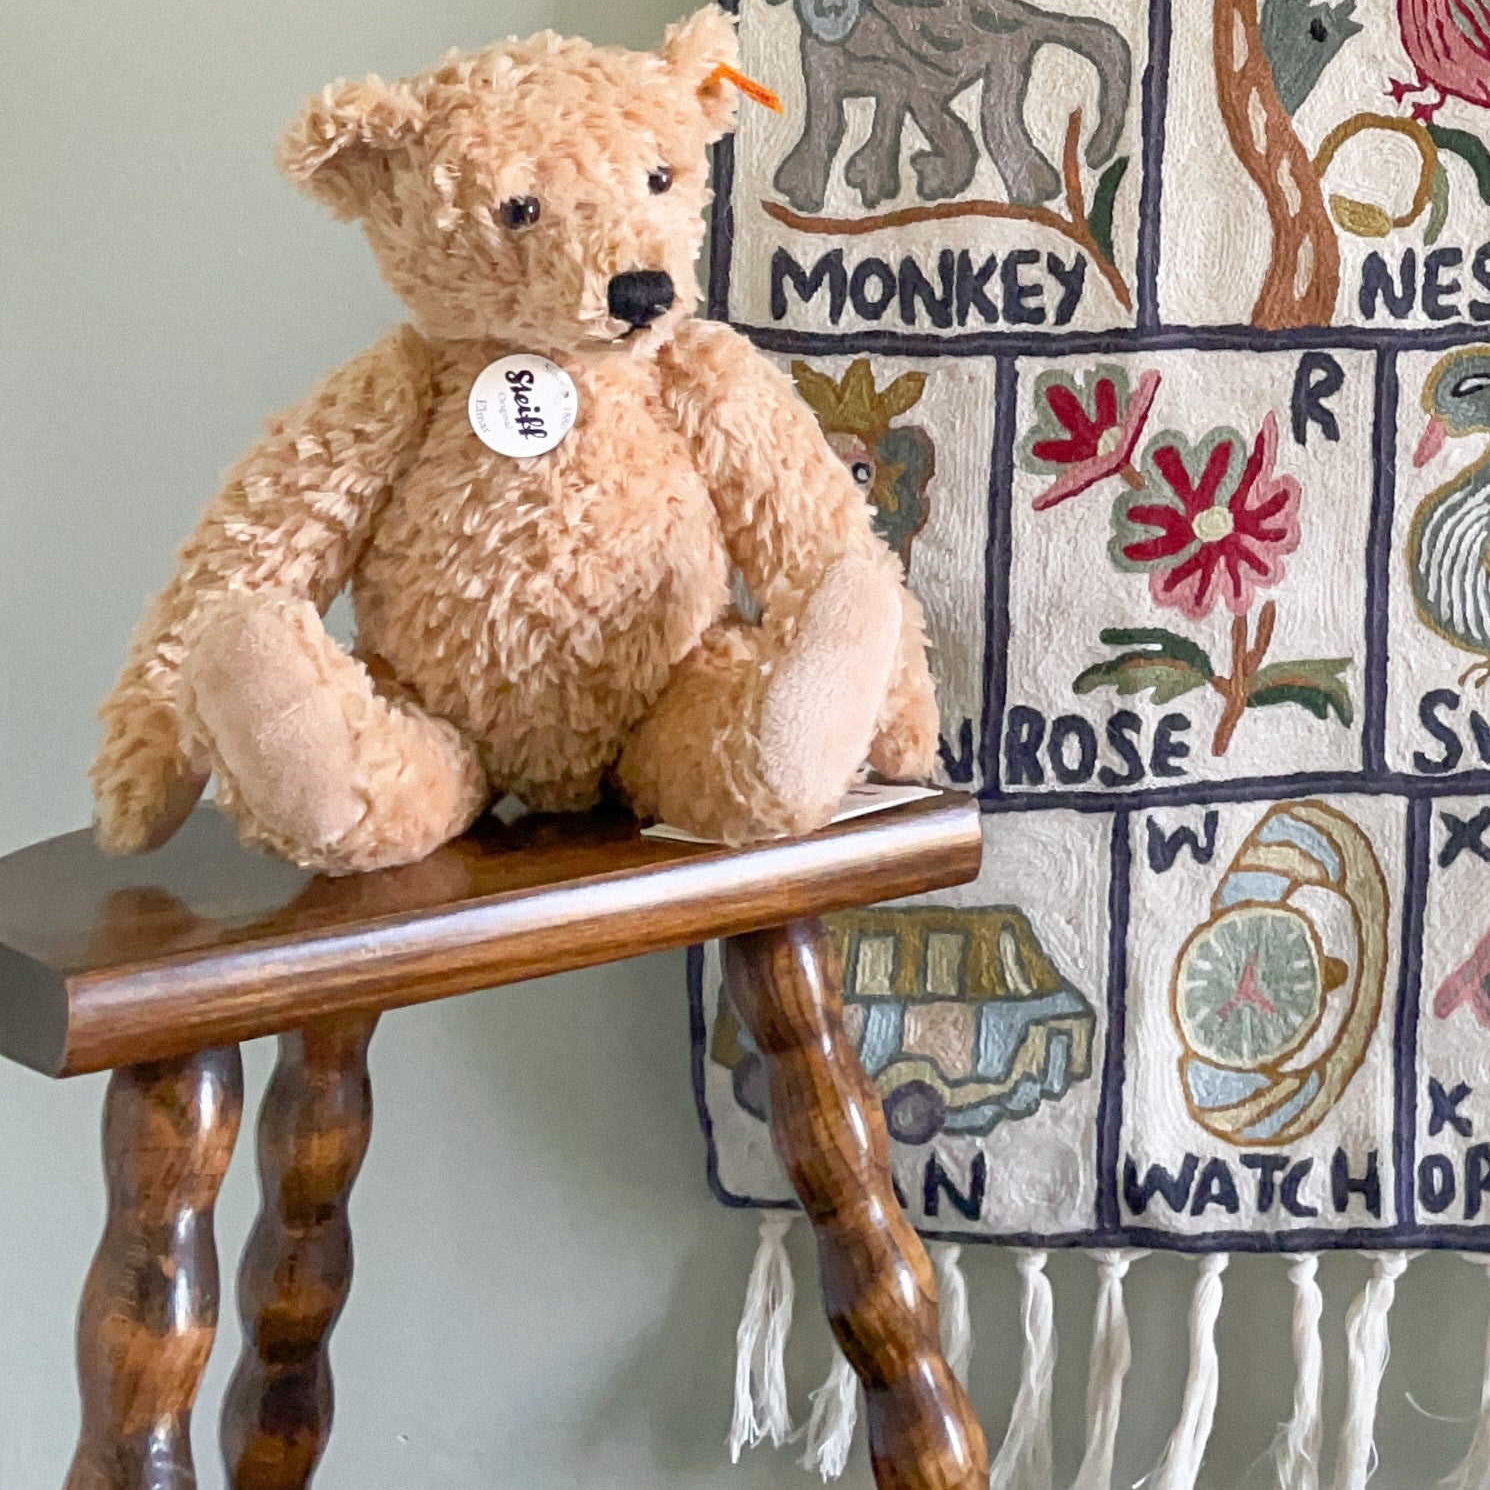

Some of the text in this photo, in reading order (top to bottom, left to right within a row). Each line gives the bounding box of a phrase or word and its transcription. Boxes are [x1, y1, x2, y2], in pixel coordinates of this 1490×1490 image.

[770, 247, 1087, 328] MONKEY
[475, 399, 491, 434] Elmar
[505, 370, 548, 440] Steiff
[1291, 351, 1344, 446] R
[1004, 706, 1190, 788] ROSE
[1147, 811, 1218, 873] W
[1122, 1152, 1381, 1219] WATCH
